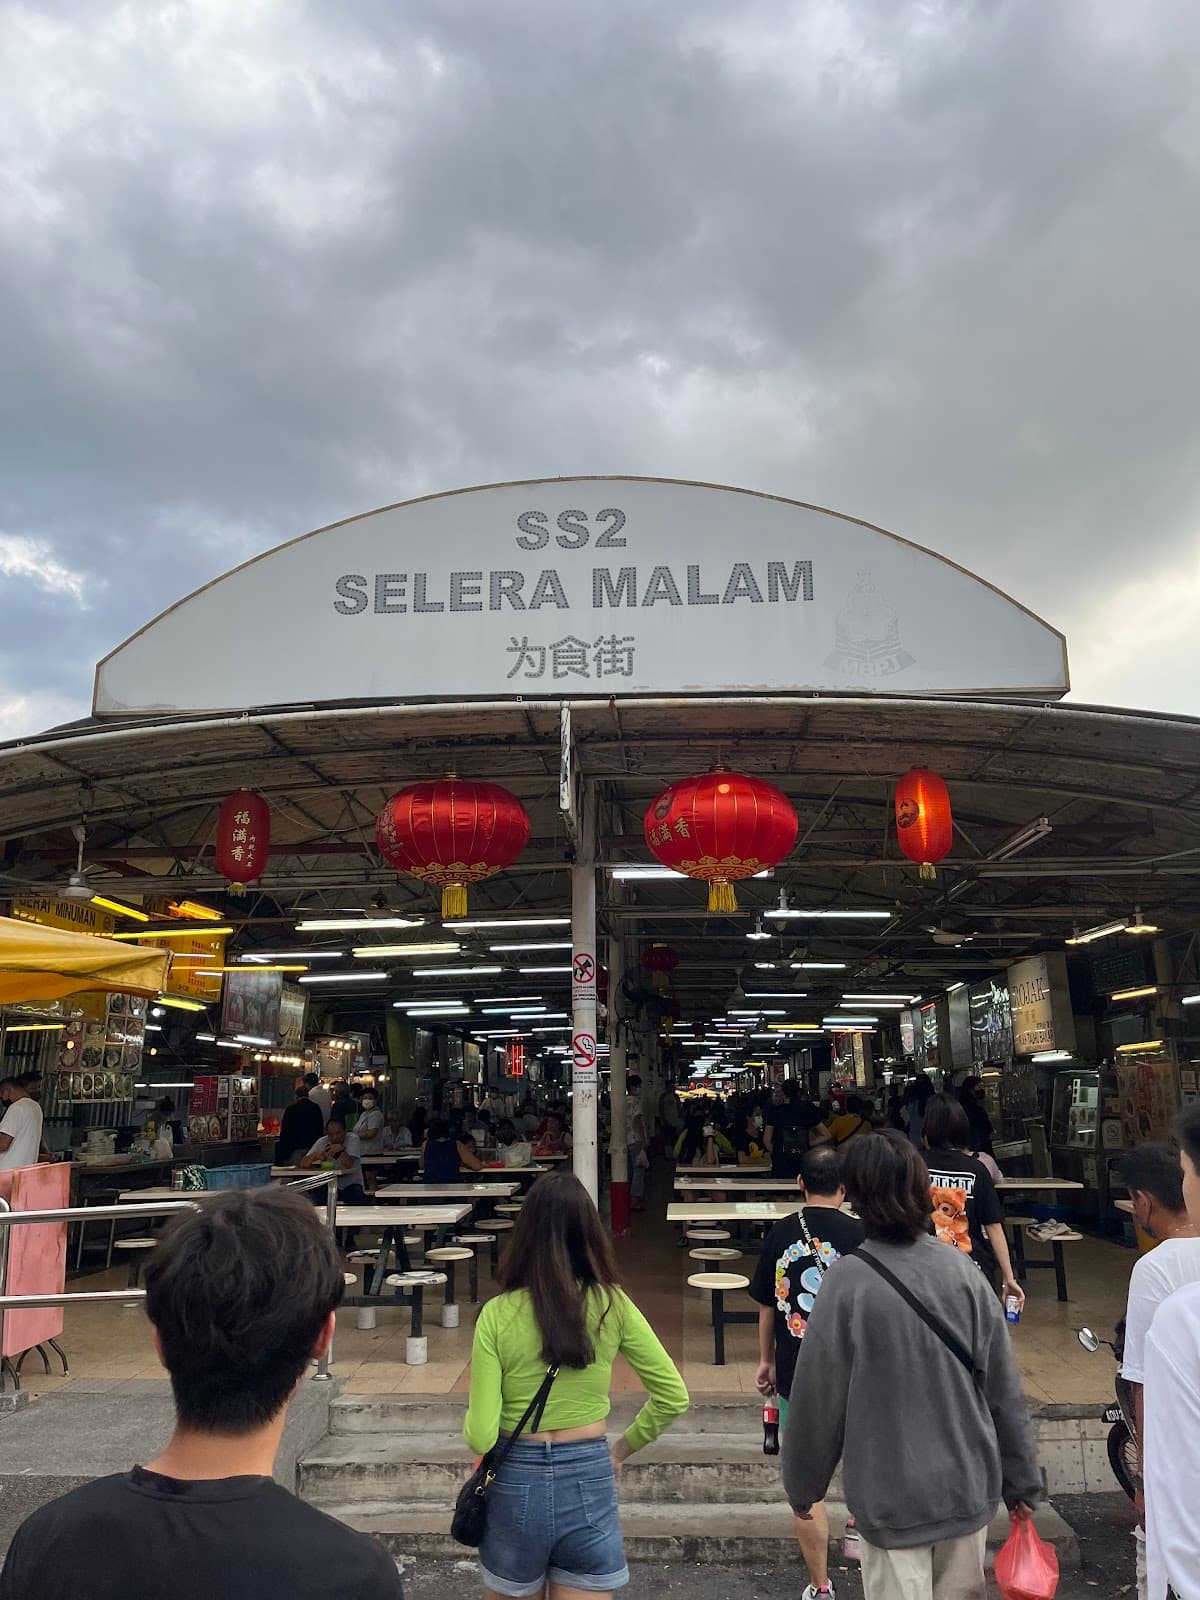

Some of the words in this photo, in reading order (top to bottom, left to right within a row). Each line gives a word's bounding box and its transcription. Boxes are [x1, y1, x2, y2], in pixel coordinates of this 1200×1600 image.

[515, 507, 627, 550] SS2
[333, 569, 570, 616] SELERA
[592, 560, 814, 609] MALAM
[506, 634, 635, 679] 为食街
[55, 901, 96, 927] MINUMAN
[1012, 977, 1046, 1008] ROJAK
